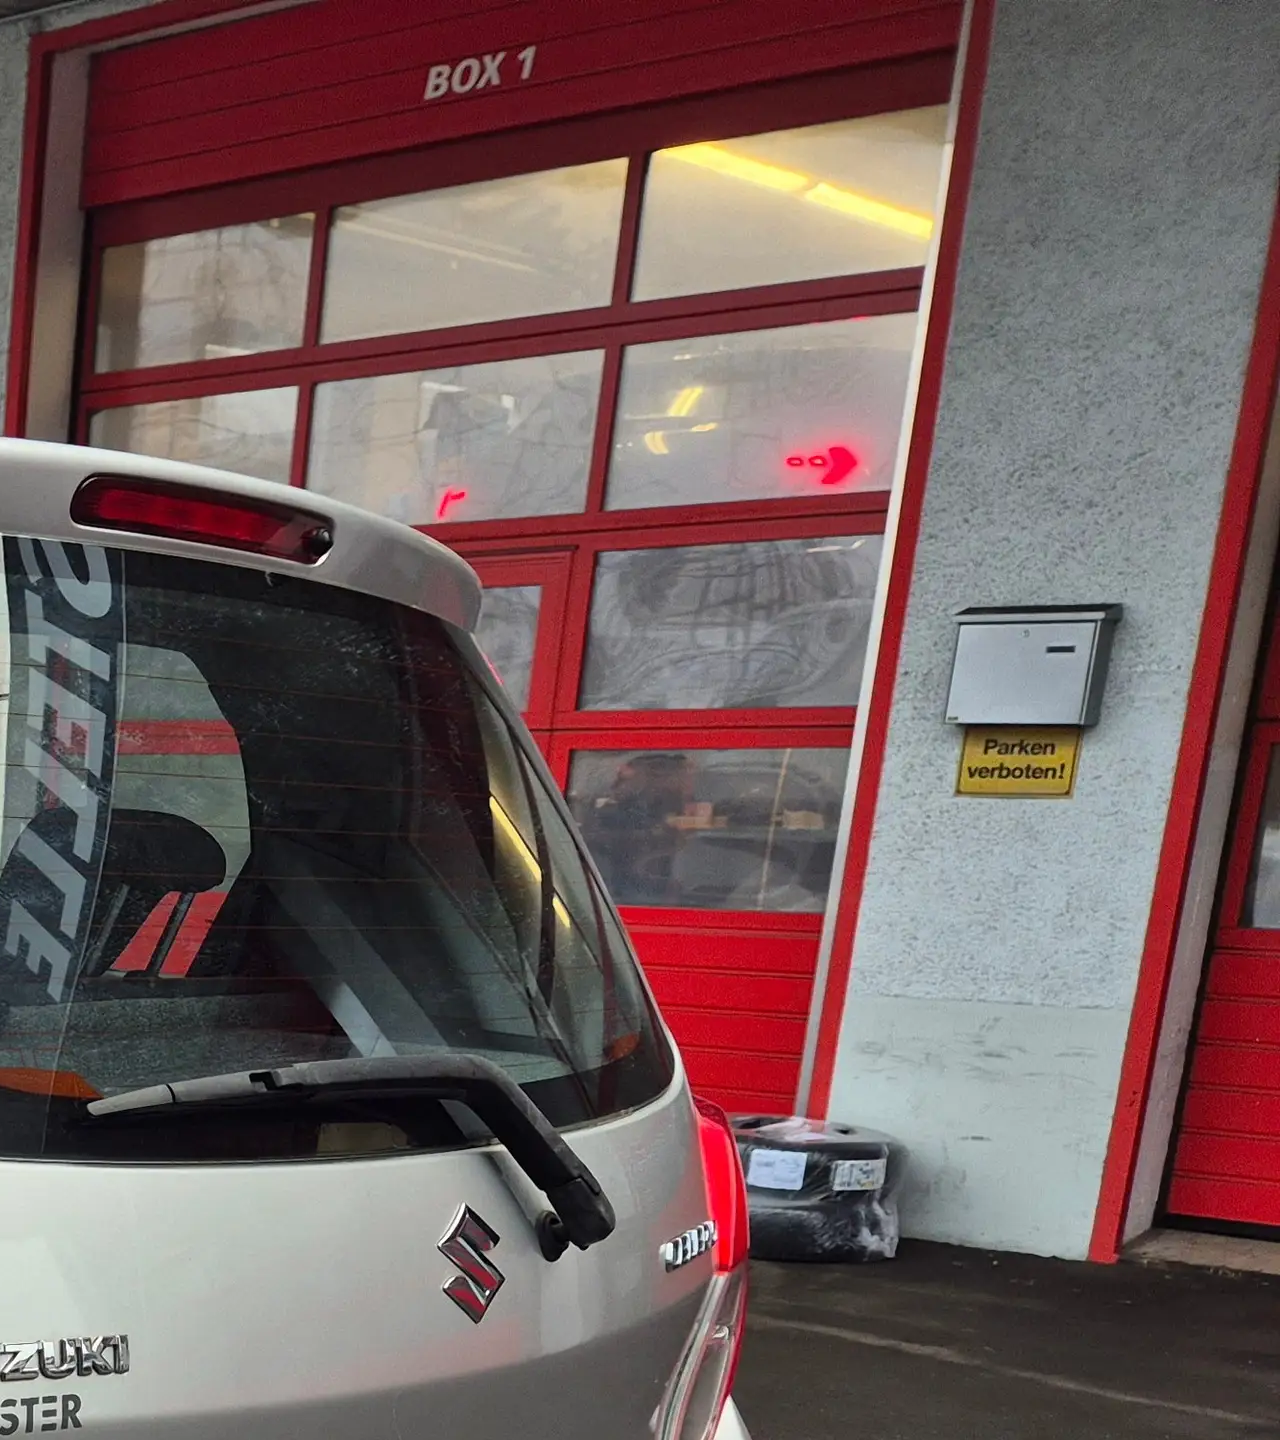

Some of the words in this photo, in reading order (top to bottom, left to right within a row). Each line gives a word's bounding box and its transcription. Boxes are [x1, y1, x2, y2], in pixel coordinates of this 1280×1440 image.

[423, 51, 507, 101] BOX
[516, 45, 537, 80] 1
[983, 738, 1056, 756] Parken
[967, 763, 1066, 780] verboten!
